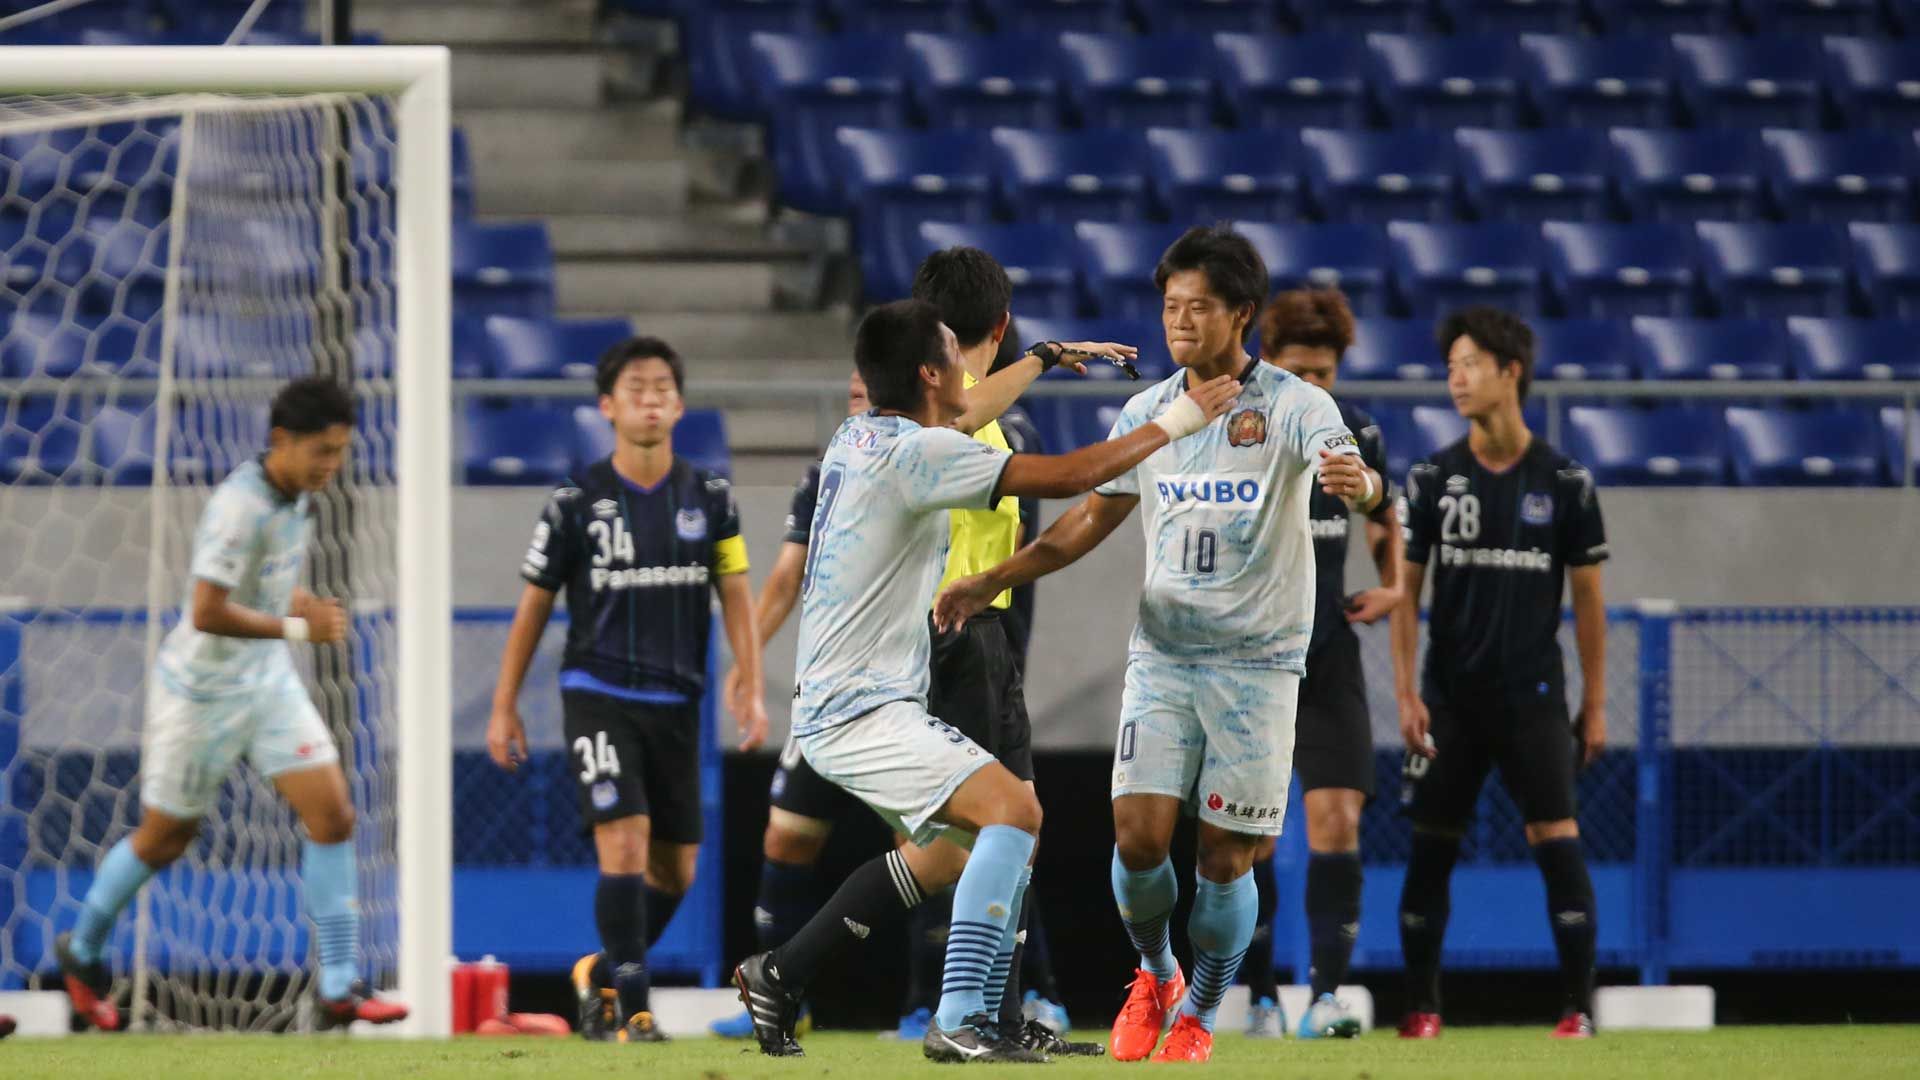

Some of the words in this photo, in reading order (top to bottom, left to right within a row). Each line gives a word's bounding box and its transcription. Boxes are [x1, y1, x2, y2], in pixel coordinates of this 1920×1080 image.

[1157, 479, 1260, 504] RYUBO
[1438, 494, 1481, 542] 28
[587, 517, 635, 567] 34
[1180, 527, 1218, 574] 10
[1440, 544, 1552, 572] Panasonic
[590, 561, 709, 591] Panasonic
[926, 718, 967, 745] 3
[573, 730, 621, 784] 34
